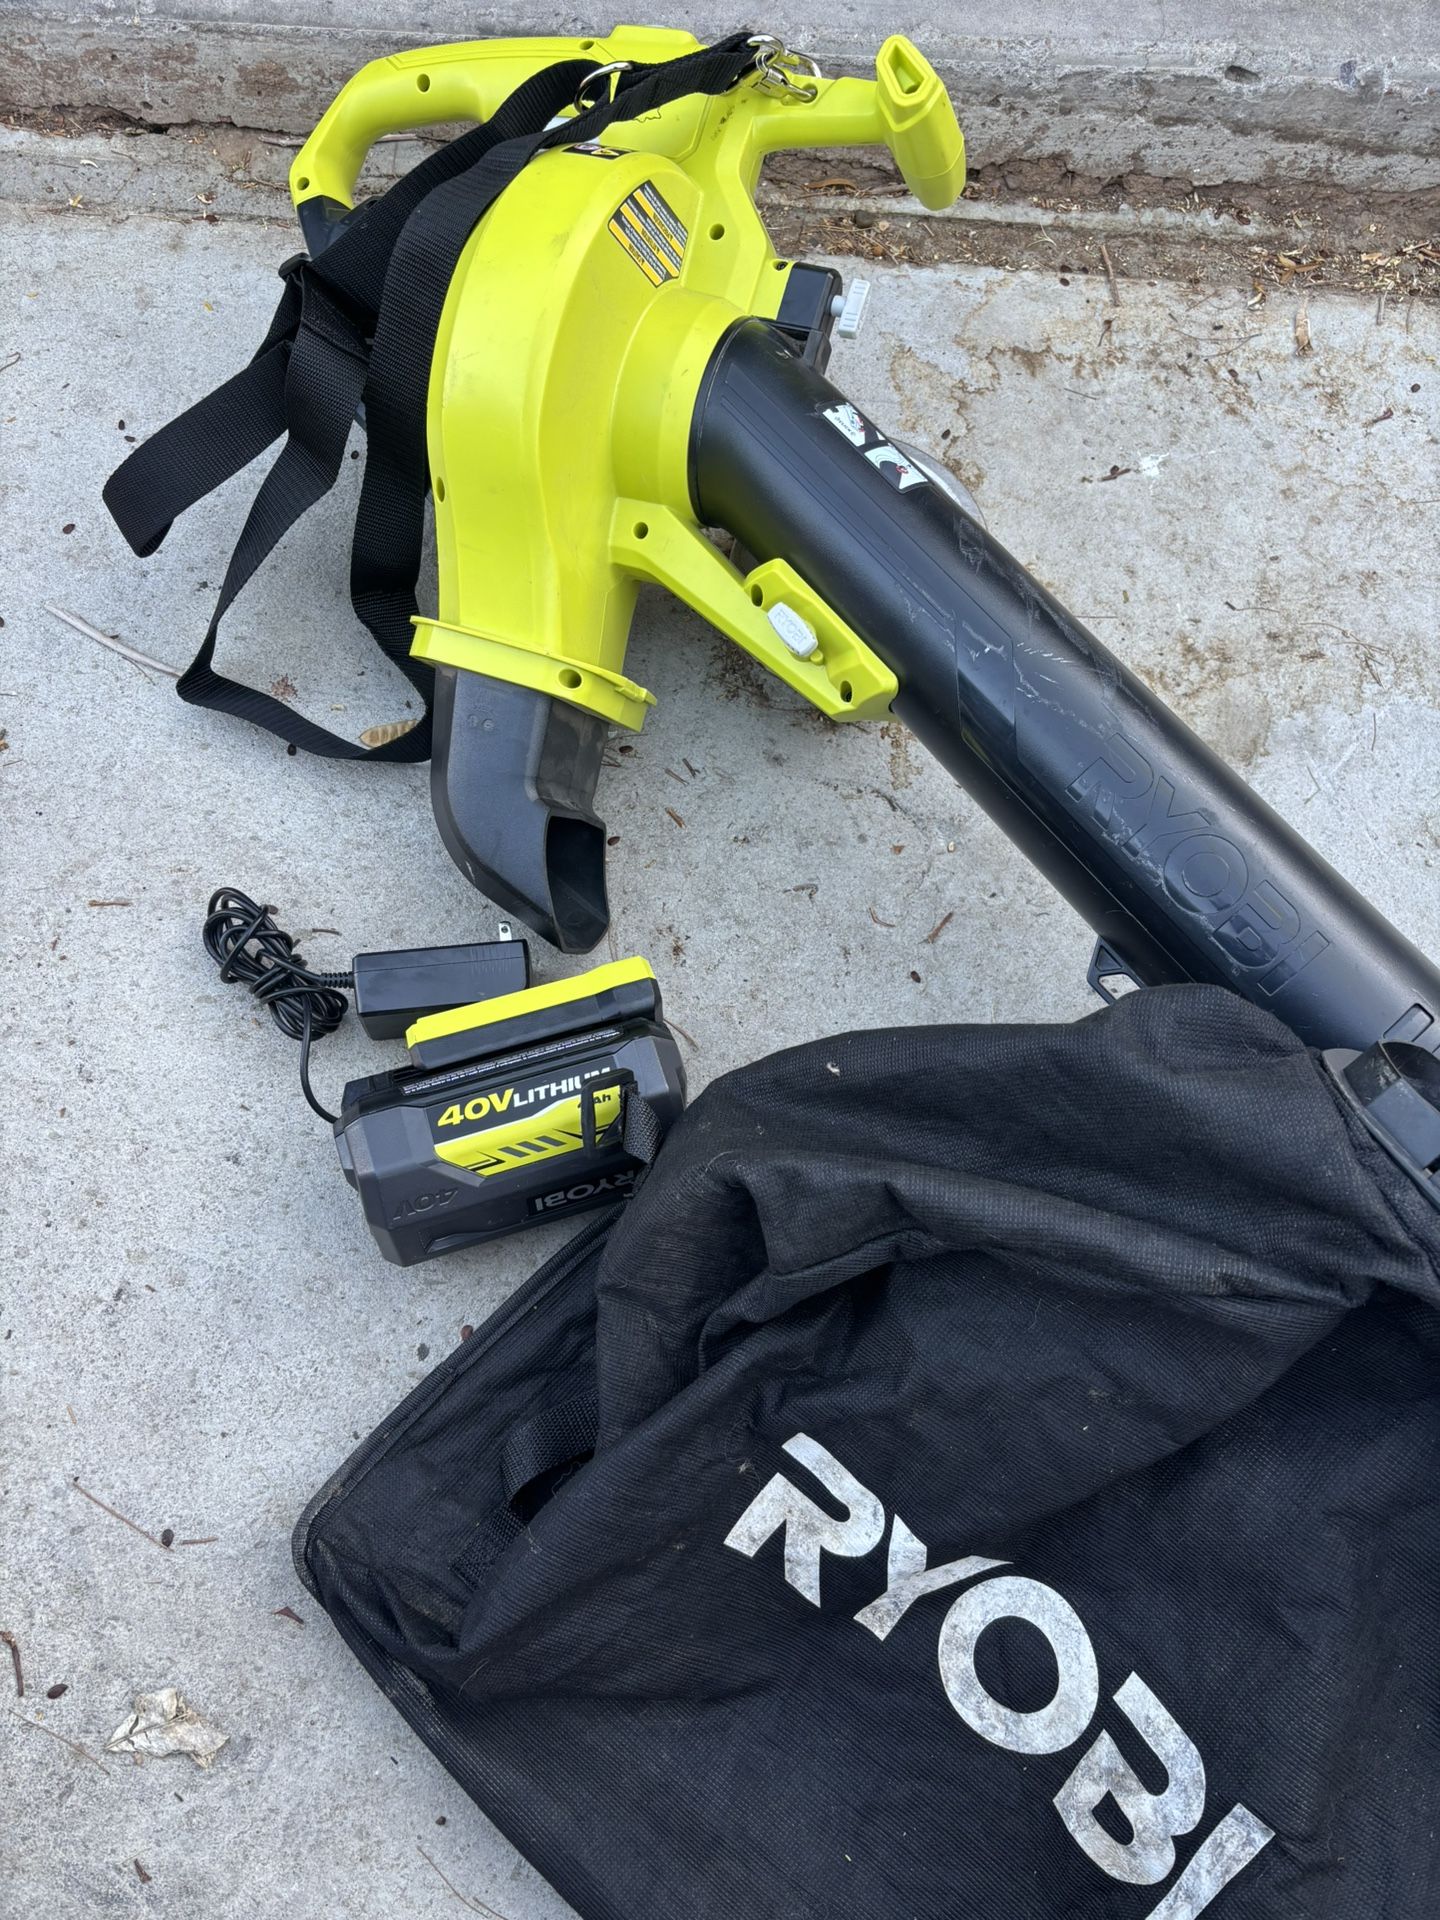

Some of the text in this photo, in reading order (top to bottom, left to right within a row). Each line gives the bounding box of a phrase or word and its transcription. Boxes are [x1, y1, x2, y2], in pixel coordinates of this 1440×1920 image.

[1065, 733, 1330, 997] RYOBI
[392, 1188, 459, 1220] 40V
[535, 1170, 635, 1211] RYOBI
[723, 1432, 1276, 1920] RYOBI
